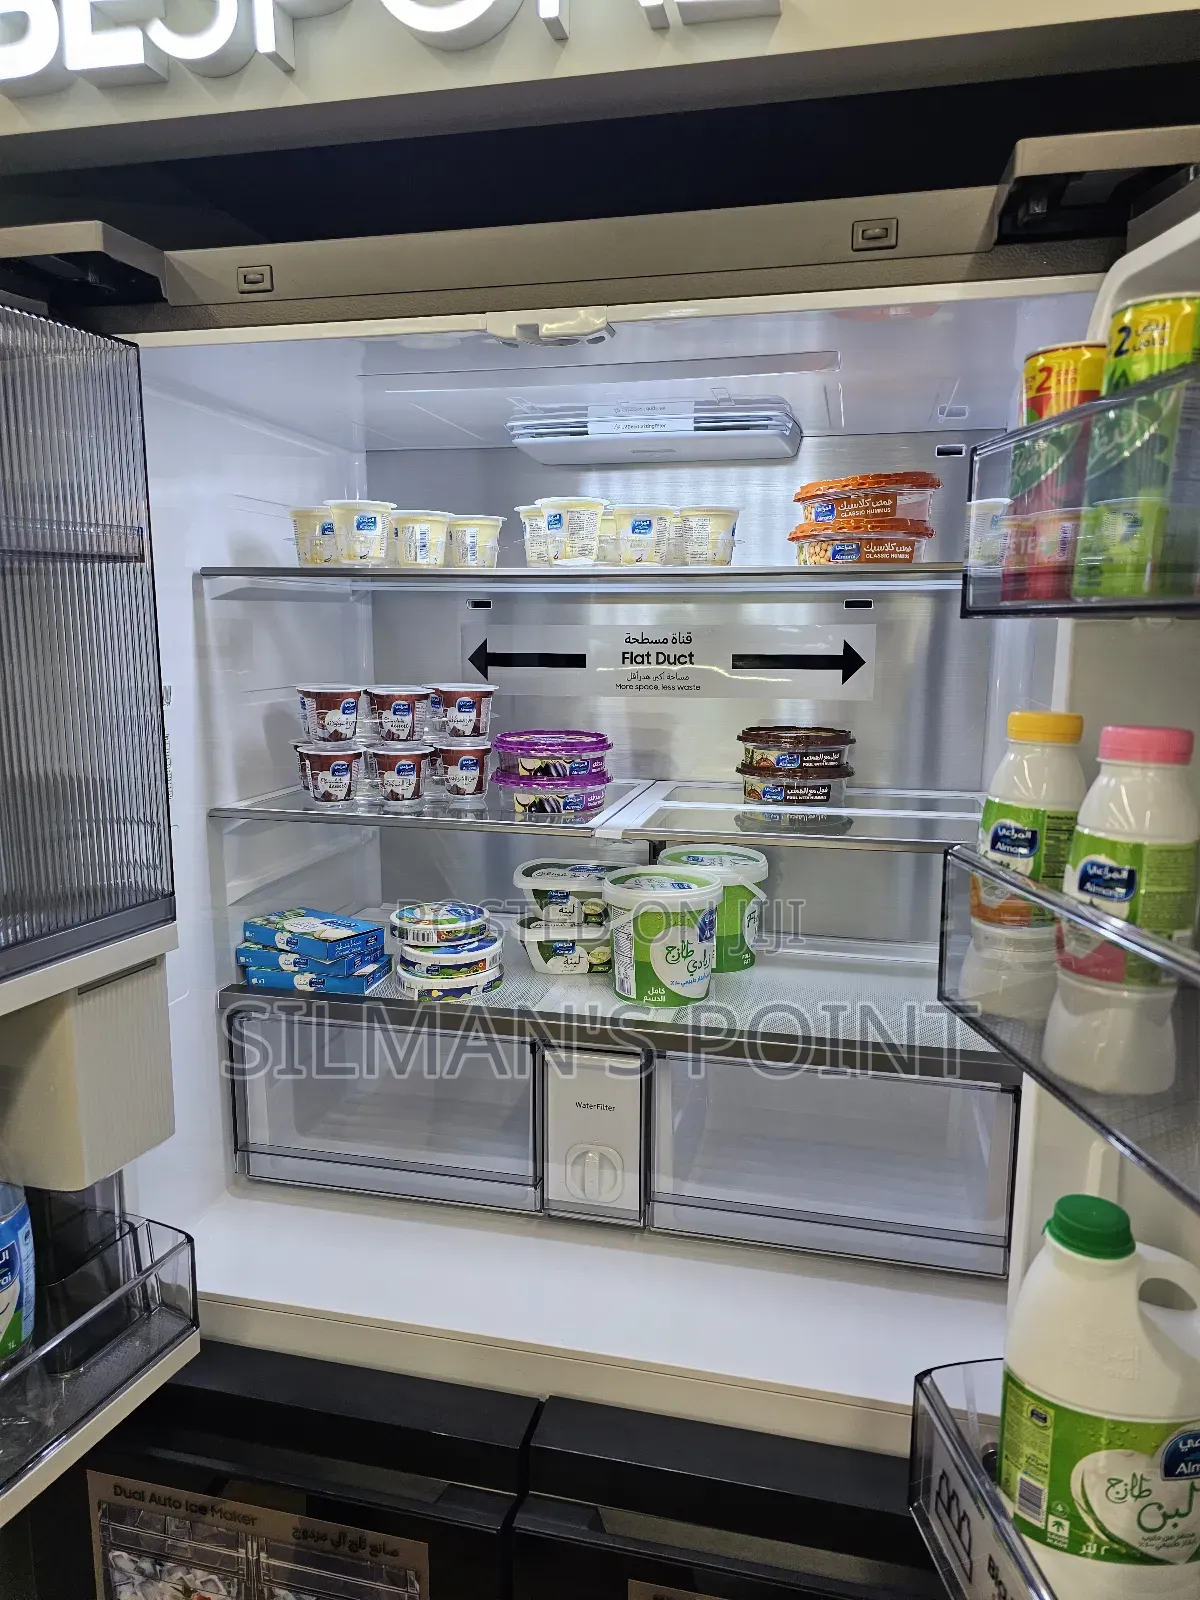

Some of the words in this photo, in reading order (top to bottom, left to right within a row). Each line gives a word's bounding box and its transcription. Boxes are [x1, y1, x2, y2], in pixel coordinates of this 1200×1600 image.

[1114, 325, 1132, 358] 2
[1036, 366, 1052, 393] 2
[624, 631, 669, 645] مسطحة
[671, 631, 693, 645] قناة
[621, 651, 651, 665] Flat
[655, 651, 694, 666] Duct
[661, 683, 676, 691] less
[676, 683, 701, 691] waste
[997, 826, 1032, 840] المراعي
[1086, 863, 1129, 880] المراعي
[665, 940, 695, 965] طازج
[643, 995, 666, 1003] الدسم
[647, 986, 666, 996] كامل
[1105, 1472, 1153, 1504] طازج
[113, 1484, 145, 1502] Dual
[148, 1491, 182, 1510] Auto
[185, 1499, 209, 1515] Ice
[210, 1503, 260, 1527] Maker
[1137, 1480, 1200, 1533] لبن
